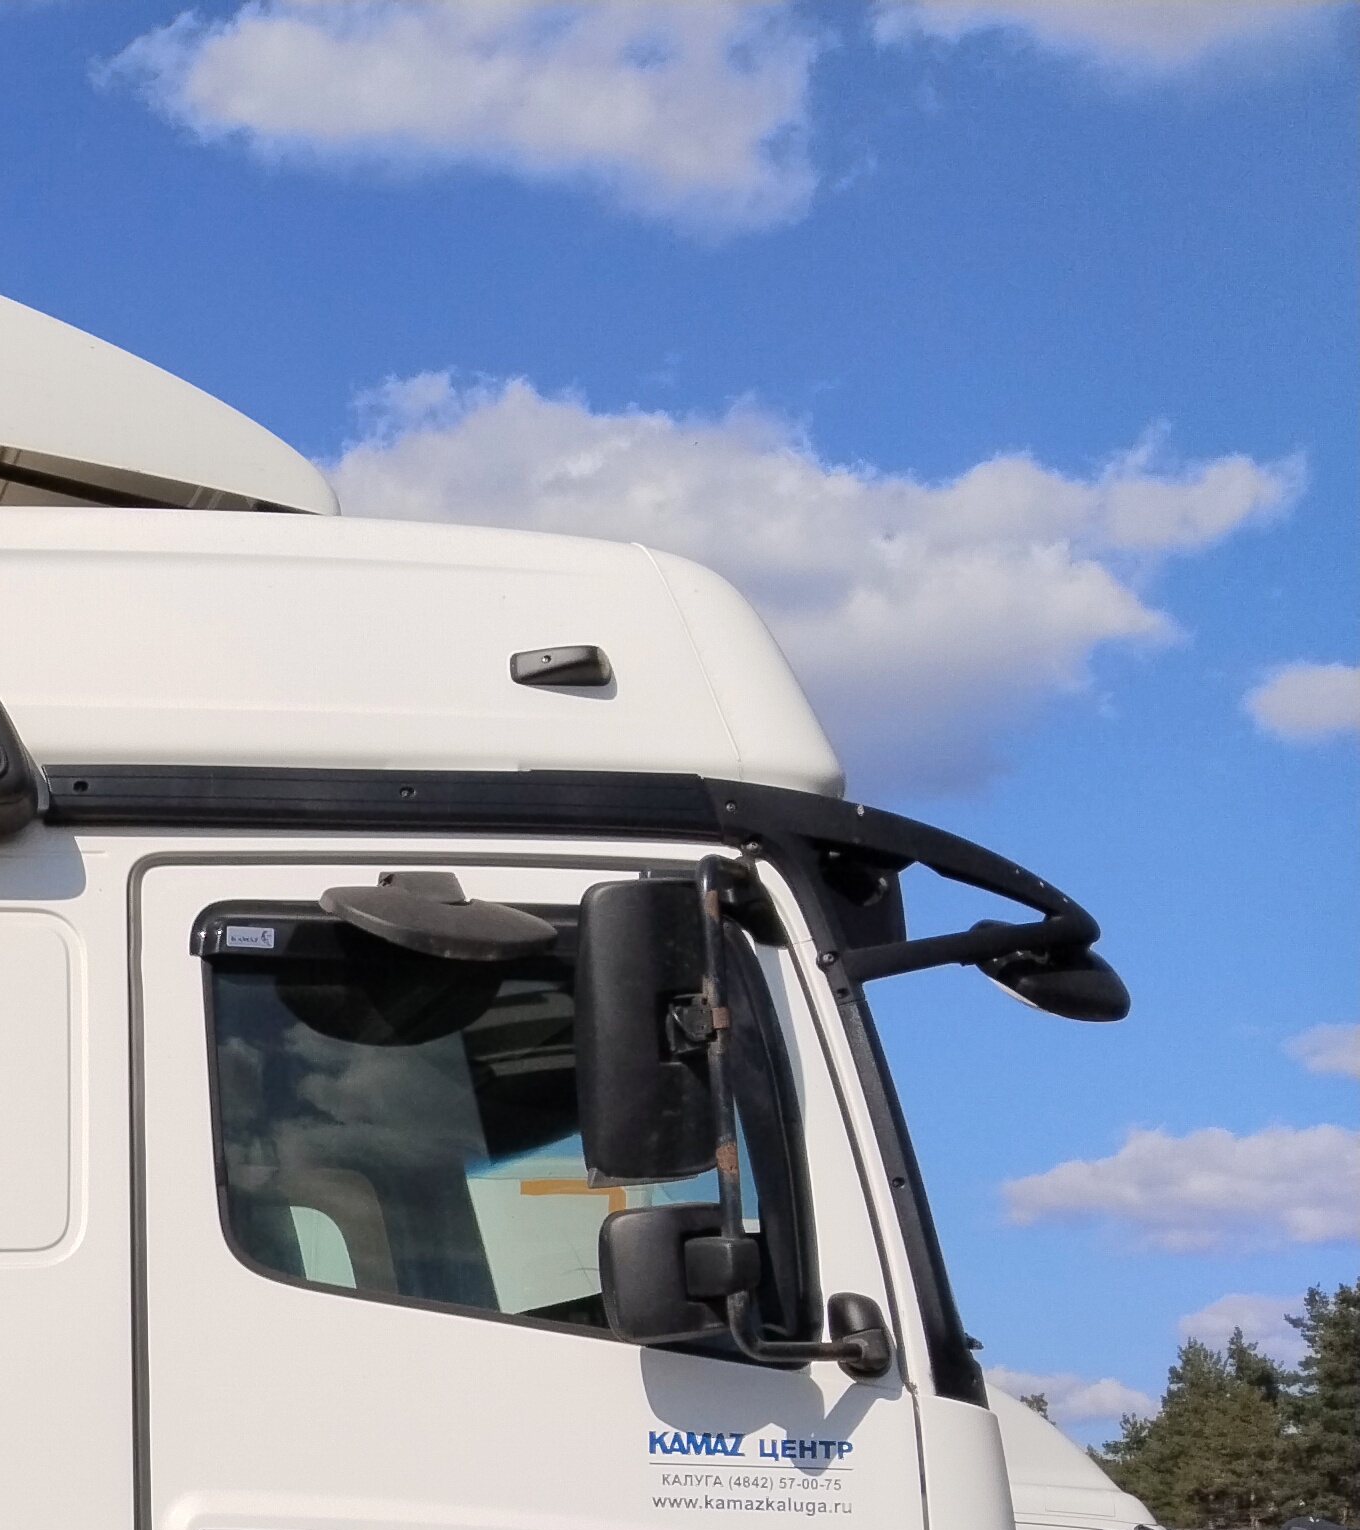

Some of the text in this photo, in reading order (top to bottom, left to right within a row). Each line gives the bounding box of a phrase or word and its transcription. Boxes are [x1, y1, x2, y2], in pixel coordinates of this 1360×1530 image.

[759, 1439, 854, 1461] ЦЕНТР
[662, 1473, 842, 1491] КАЛУГА (4842) 57-00-75
[652, 1495, 853, 1516] www.kamazkaluga.ru
